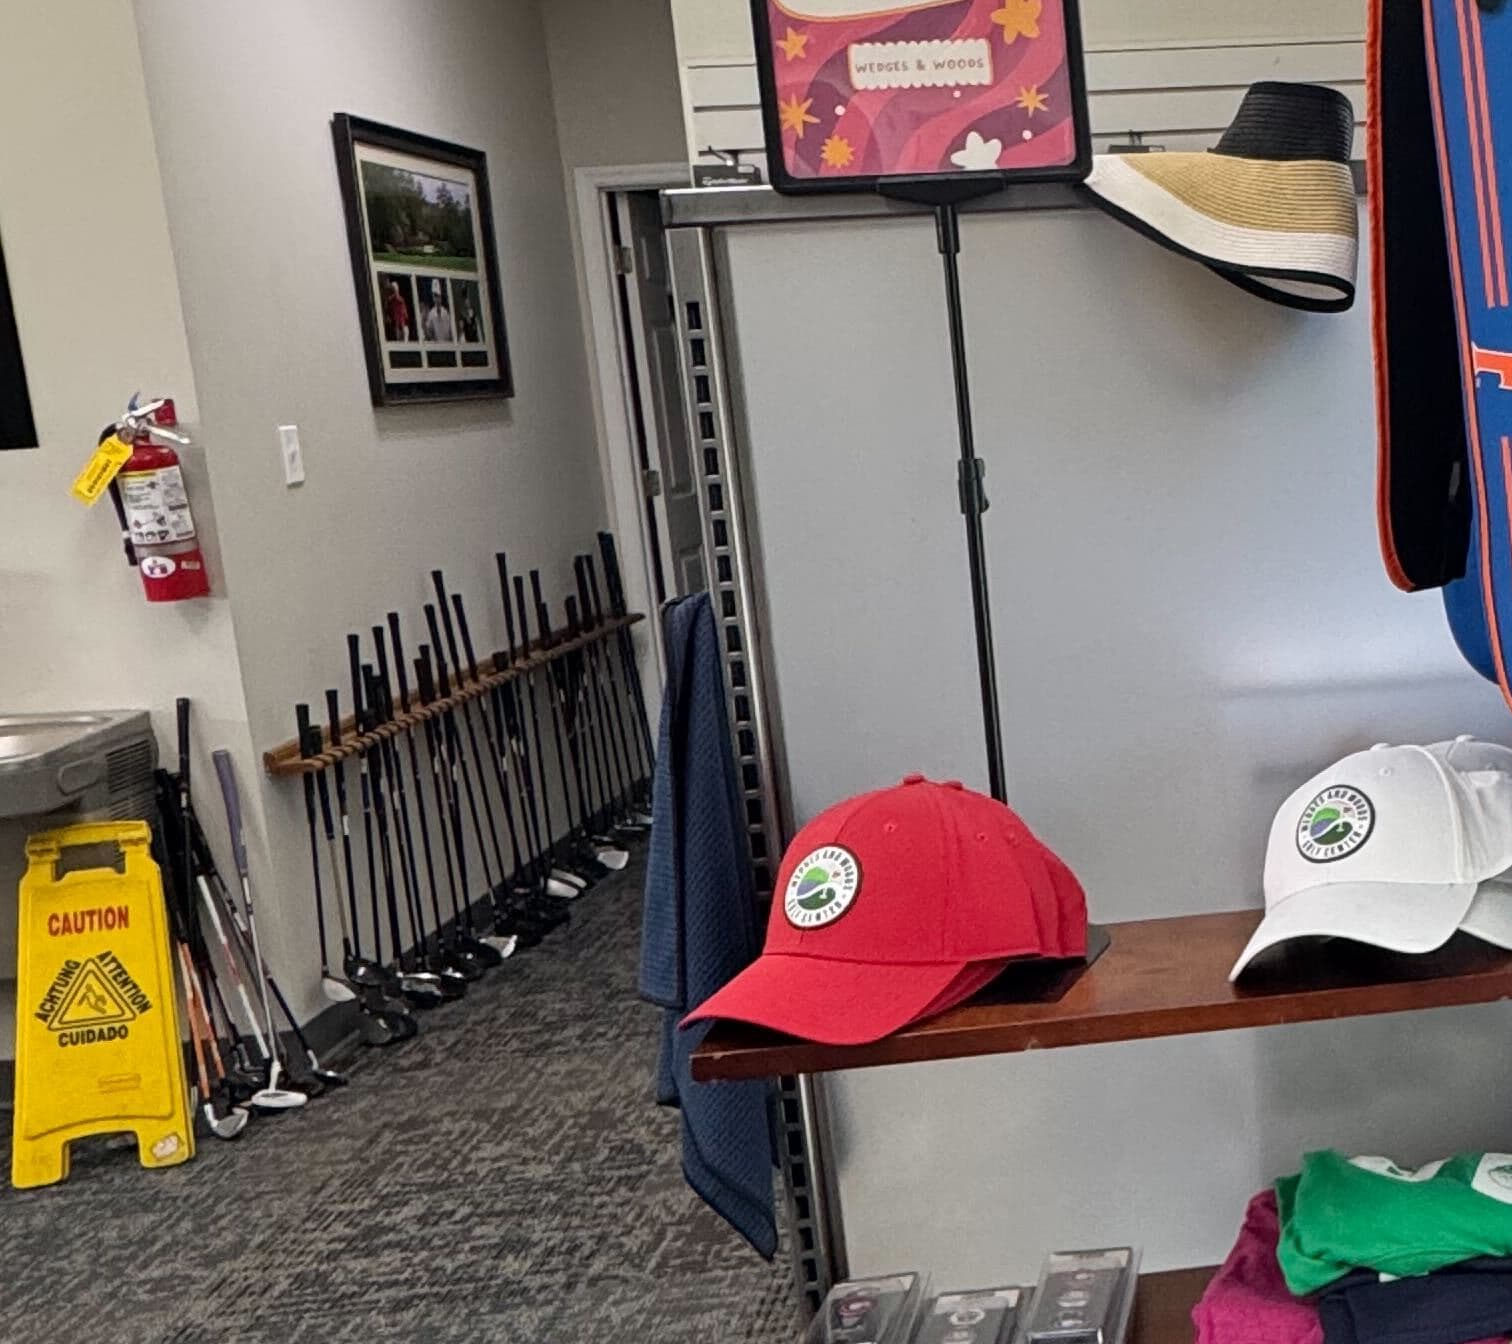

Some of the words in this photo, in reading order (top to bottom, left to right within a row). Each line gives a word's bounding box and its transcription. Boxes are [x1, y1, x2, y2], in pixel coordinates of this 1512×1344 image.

[855, 61, 908, 73] WEDGES
[917, 59, 926, 71] &
[933, 58, 984, 70] WOODS
[47, 906, 130, 937] CAUTION
[34, 958, 81, 1023] ACHTUNG
[96, 950, 154, 1015] ATTENTION
[58, 1026, 129, 1048] CUIDADO
